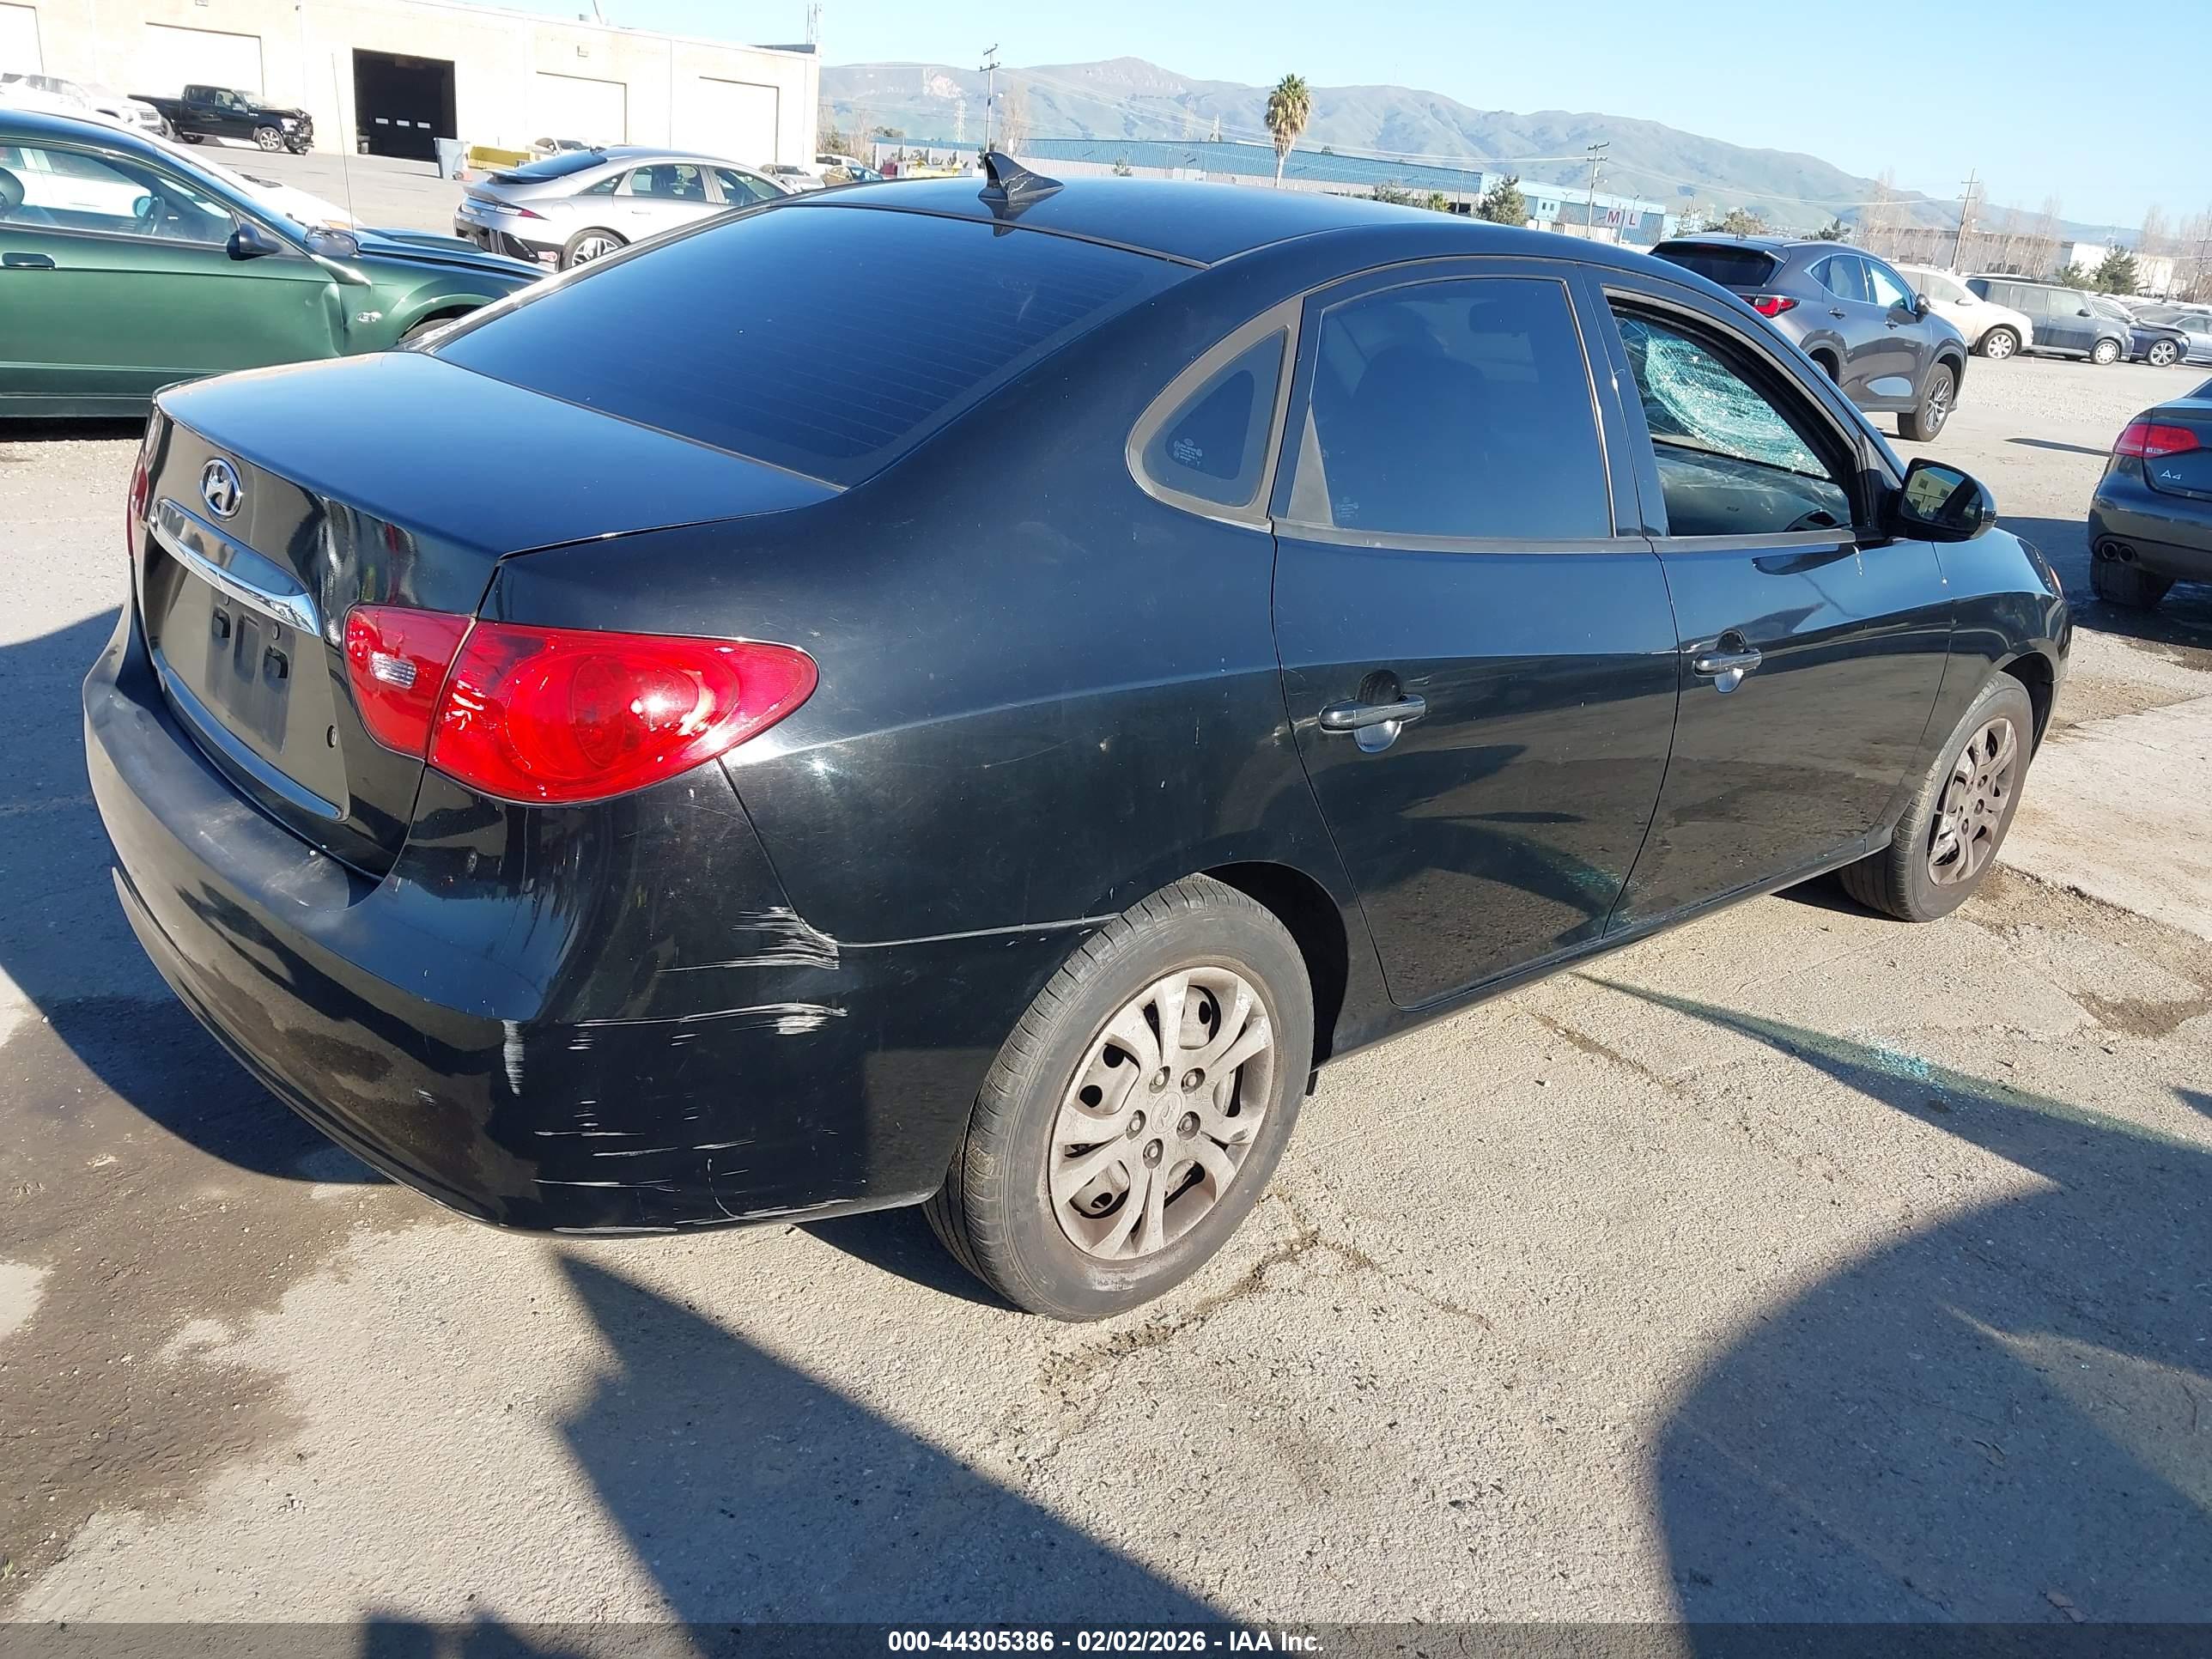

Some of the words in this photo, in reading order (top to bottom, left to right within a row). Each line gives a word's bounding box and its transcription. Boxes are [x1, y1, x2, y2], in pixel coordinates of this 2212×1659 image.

[1607, 210, 1621, 224] M
[1628, 212, 1636, 226] L
[2160, 469, 2182, 480] A4
